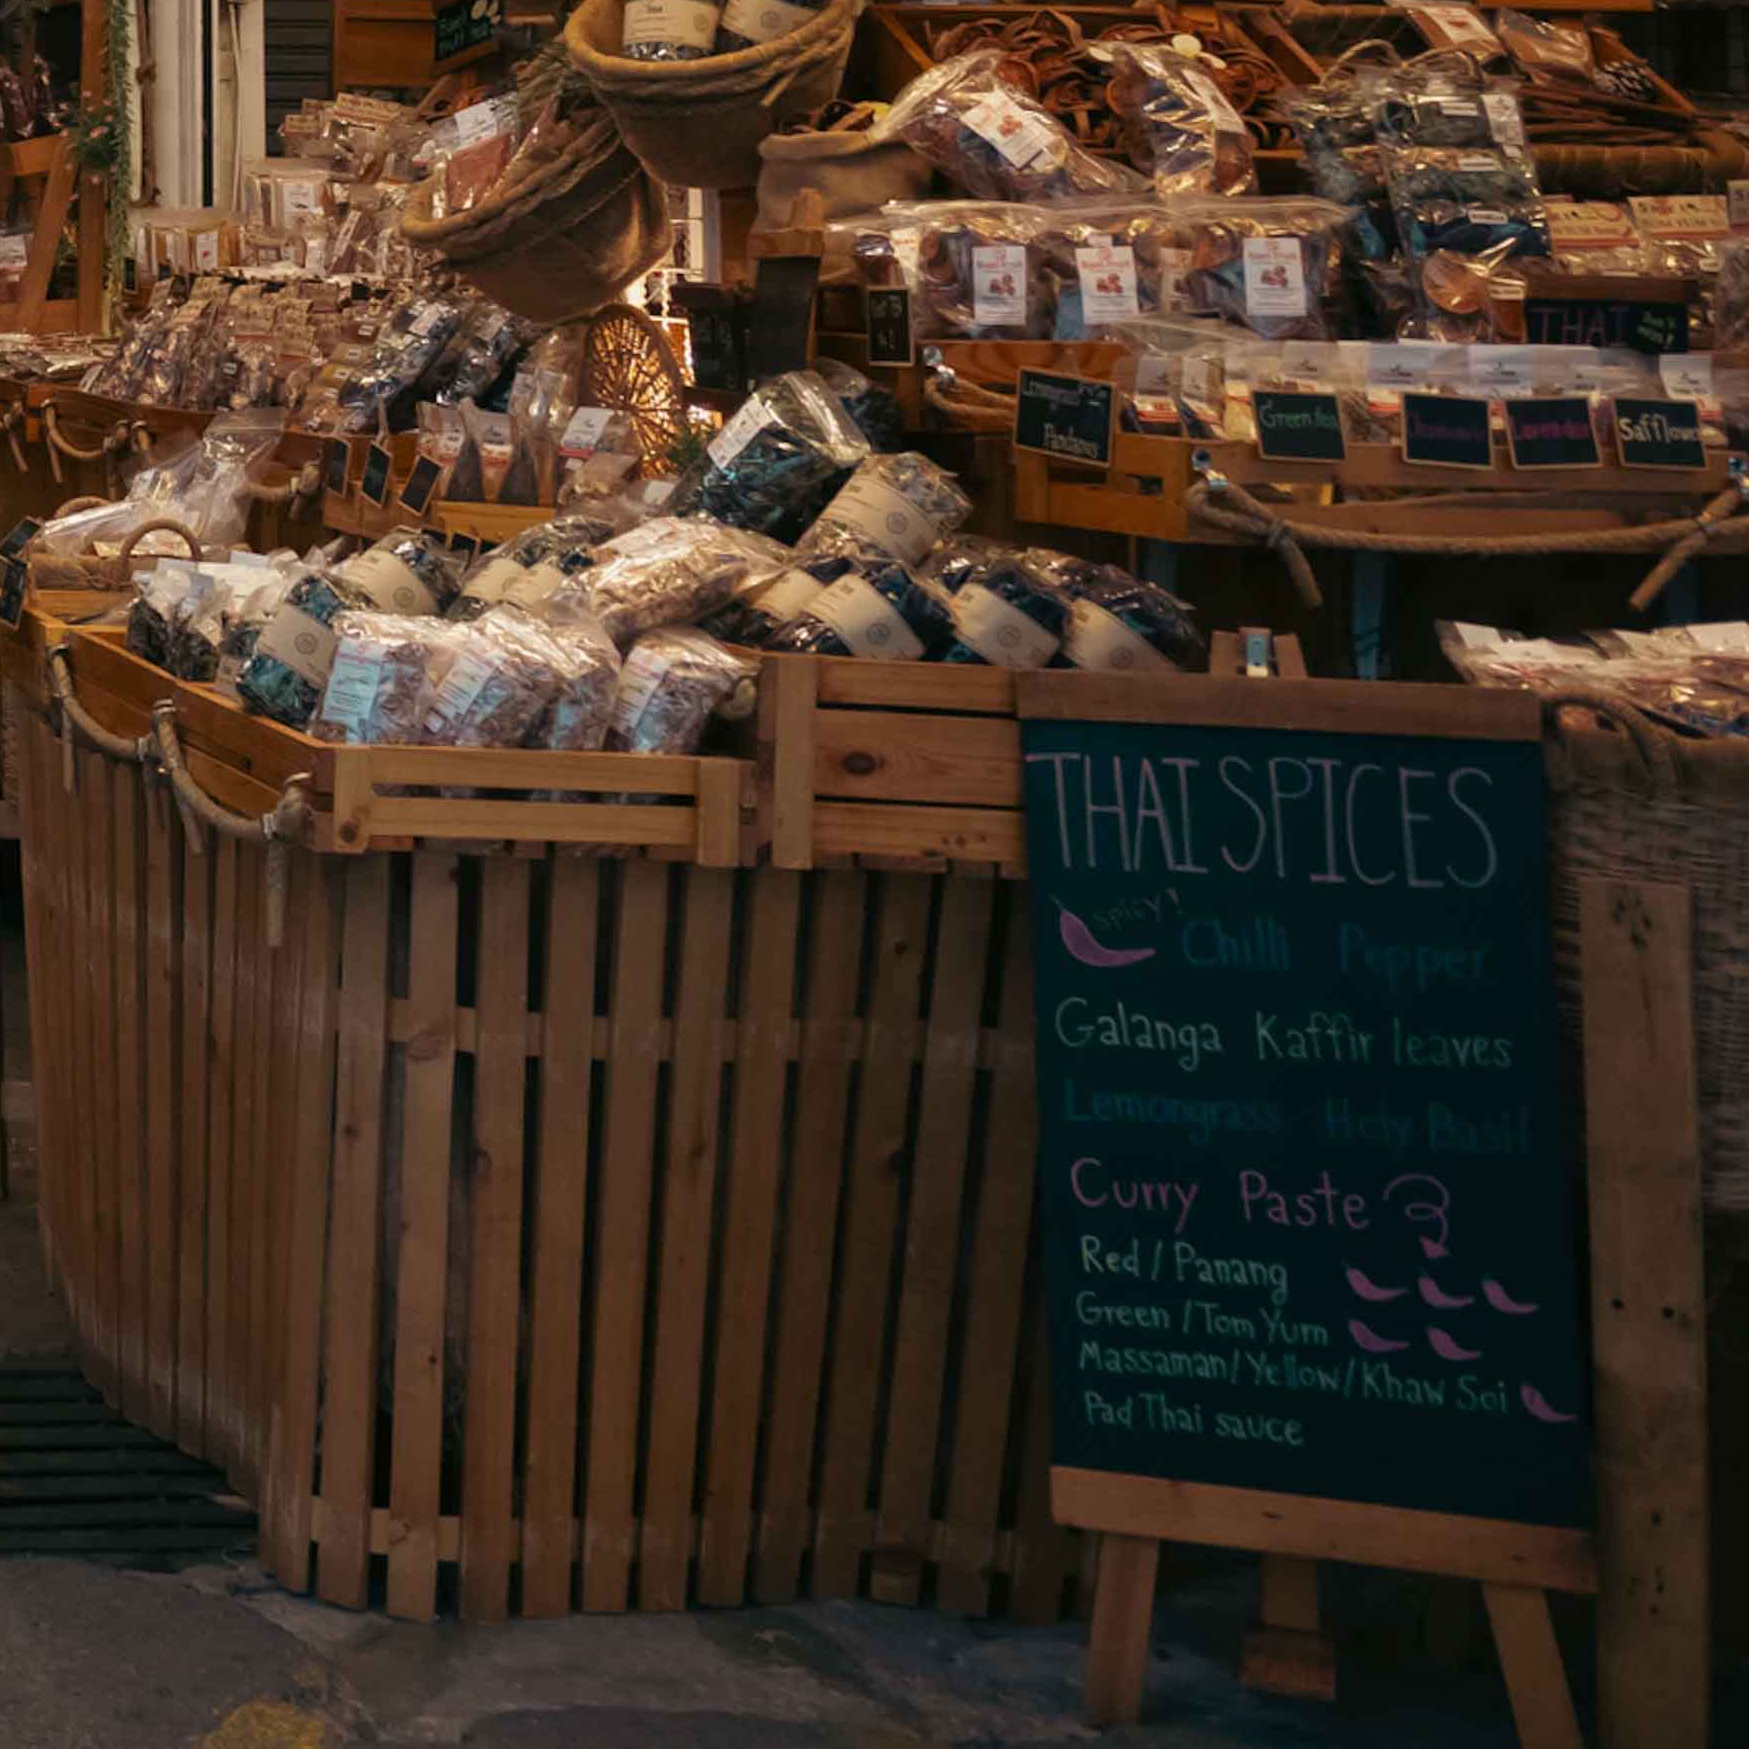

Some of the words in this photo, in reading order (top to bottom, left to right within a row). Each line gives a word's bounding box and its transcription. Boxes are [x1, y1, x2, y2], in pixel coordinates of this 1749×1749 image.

[1026, 752, 1209, 874] THAI
[1219, 756, 1498, 889] SPICES
[1181, 916, 1291, 971] Chilli
[1338, 922, 1490, 990] Pepper
[1054, 995, 1223, 1071] Galanga
[1256, 1010, 1373, 1062] Kaffir
[1392, 1017, 1514, 1069] leaves
[1062, 1078, 1280, 1147] Lemongrass
[1426, 1100, 1531, 1155] Basil
[1070, 1156, 1199, 1234] Curry
[1237, 1168, 1370, 1230] Paste
[1080, 1235, 1141, 1274] Red
[1173, 1241, 1289, 1306] Panang
[1074, 1290, 1171, 1331] Green
[1259, 1304, 1330, 1347] Yum
[1084, 1392, 1132, 1429] Pad
[1139, 1392, 1203, 1434] Thai
[1215, 1410, 1305, 1447] sauce
